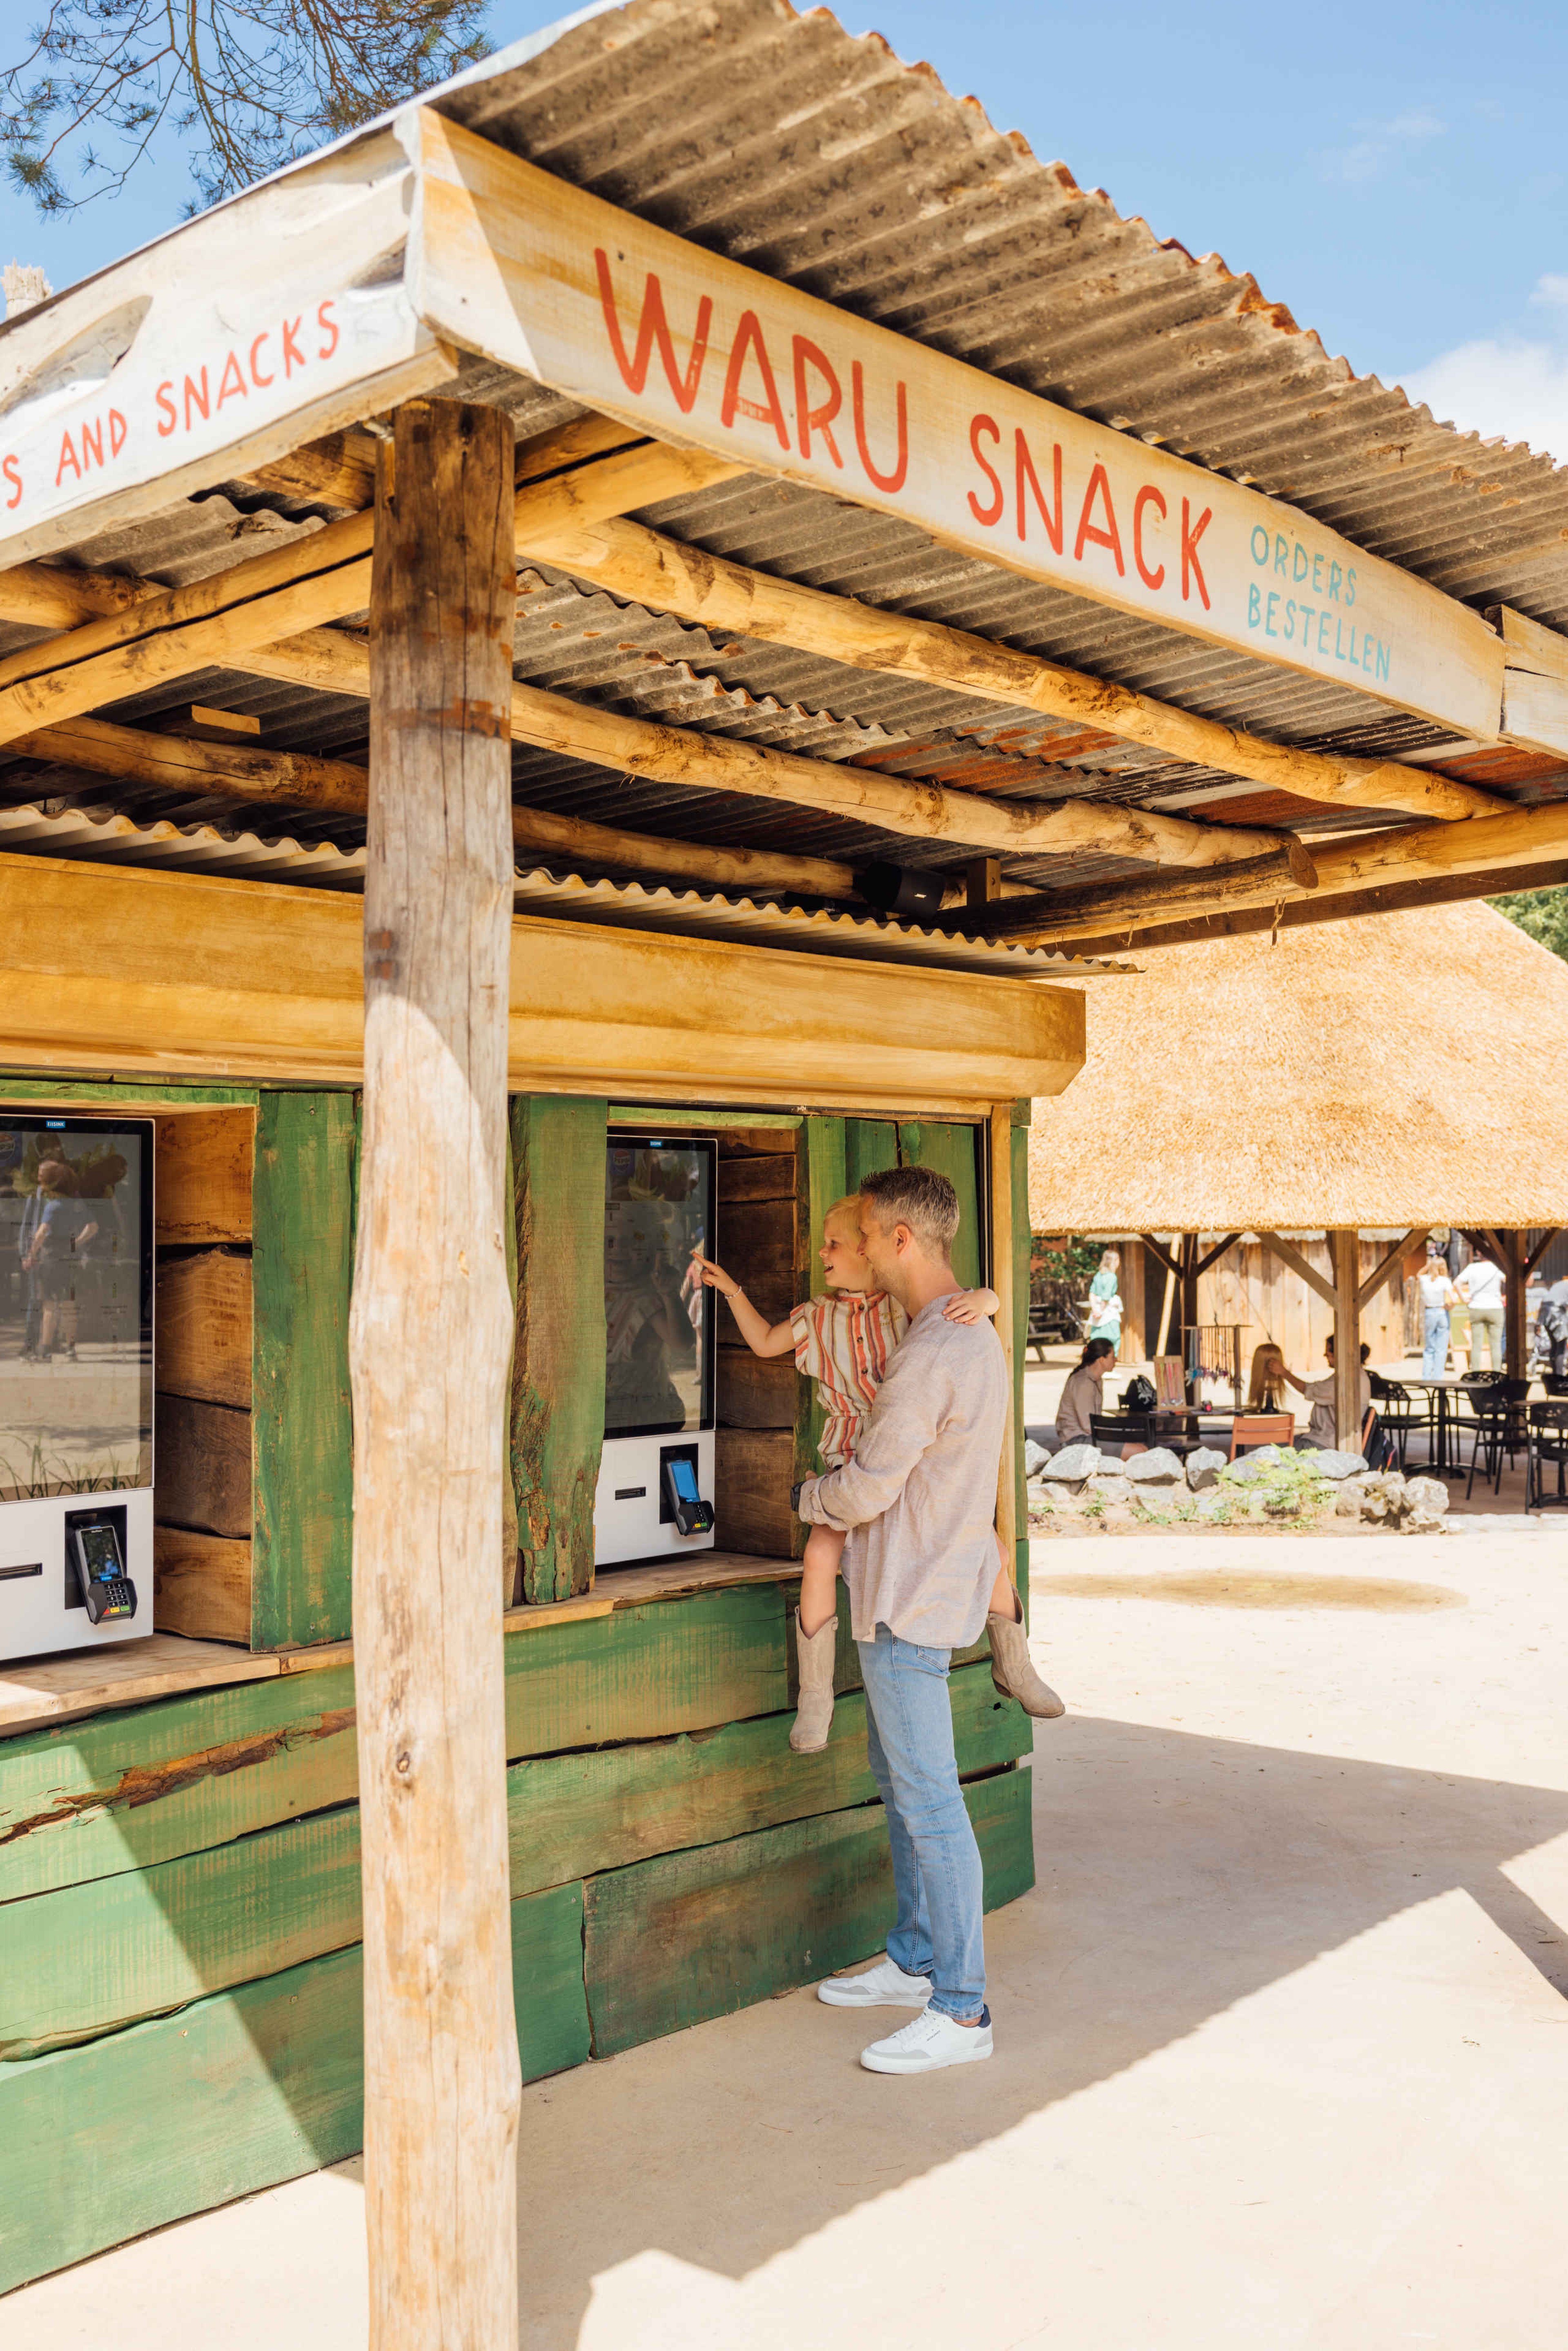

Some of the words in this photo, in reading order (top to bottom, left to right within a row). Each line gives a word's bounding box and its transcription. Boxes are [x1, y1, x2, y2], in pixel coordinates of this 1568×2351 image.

[56, 409, 127, 487] AND
[156, 301, 339, 437] SNACKS
[595, 247, 908, 493] WARU
[967, 413, 1212, 611] SNACK
[1248, 583, 1390, 683] BESTELLEN
[1251, 525, 1356, 606] ORDERS
